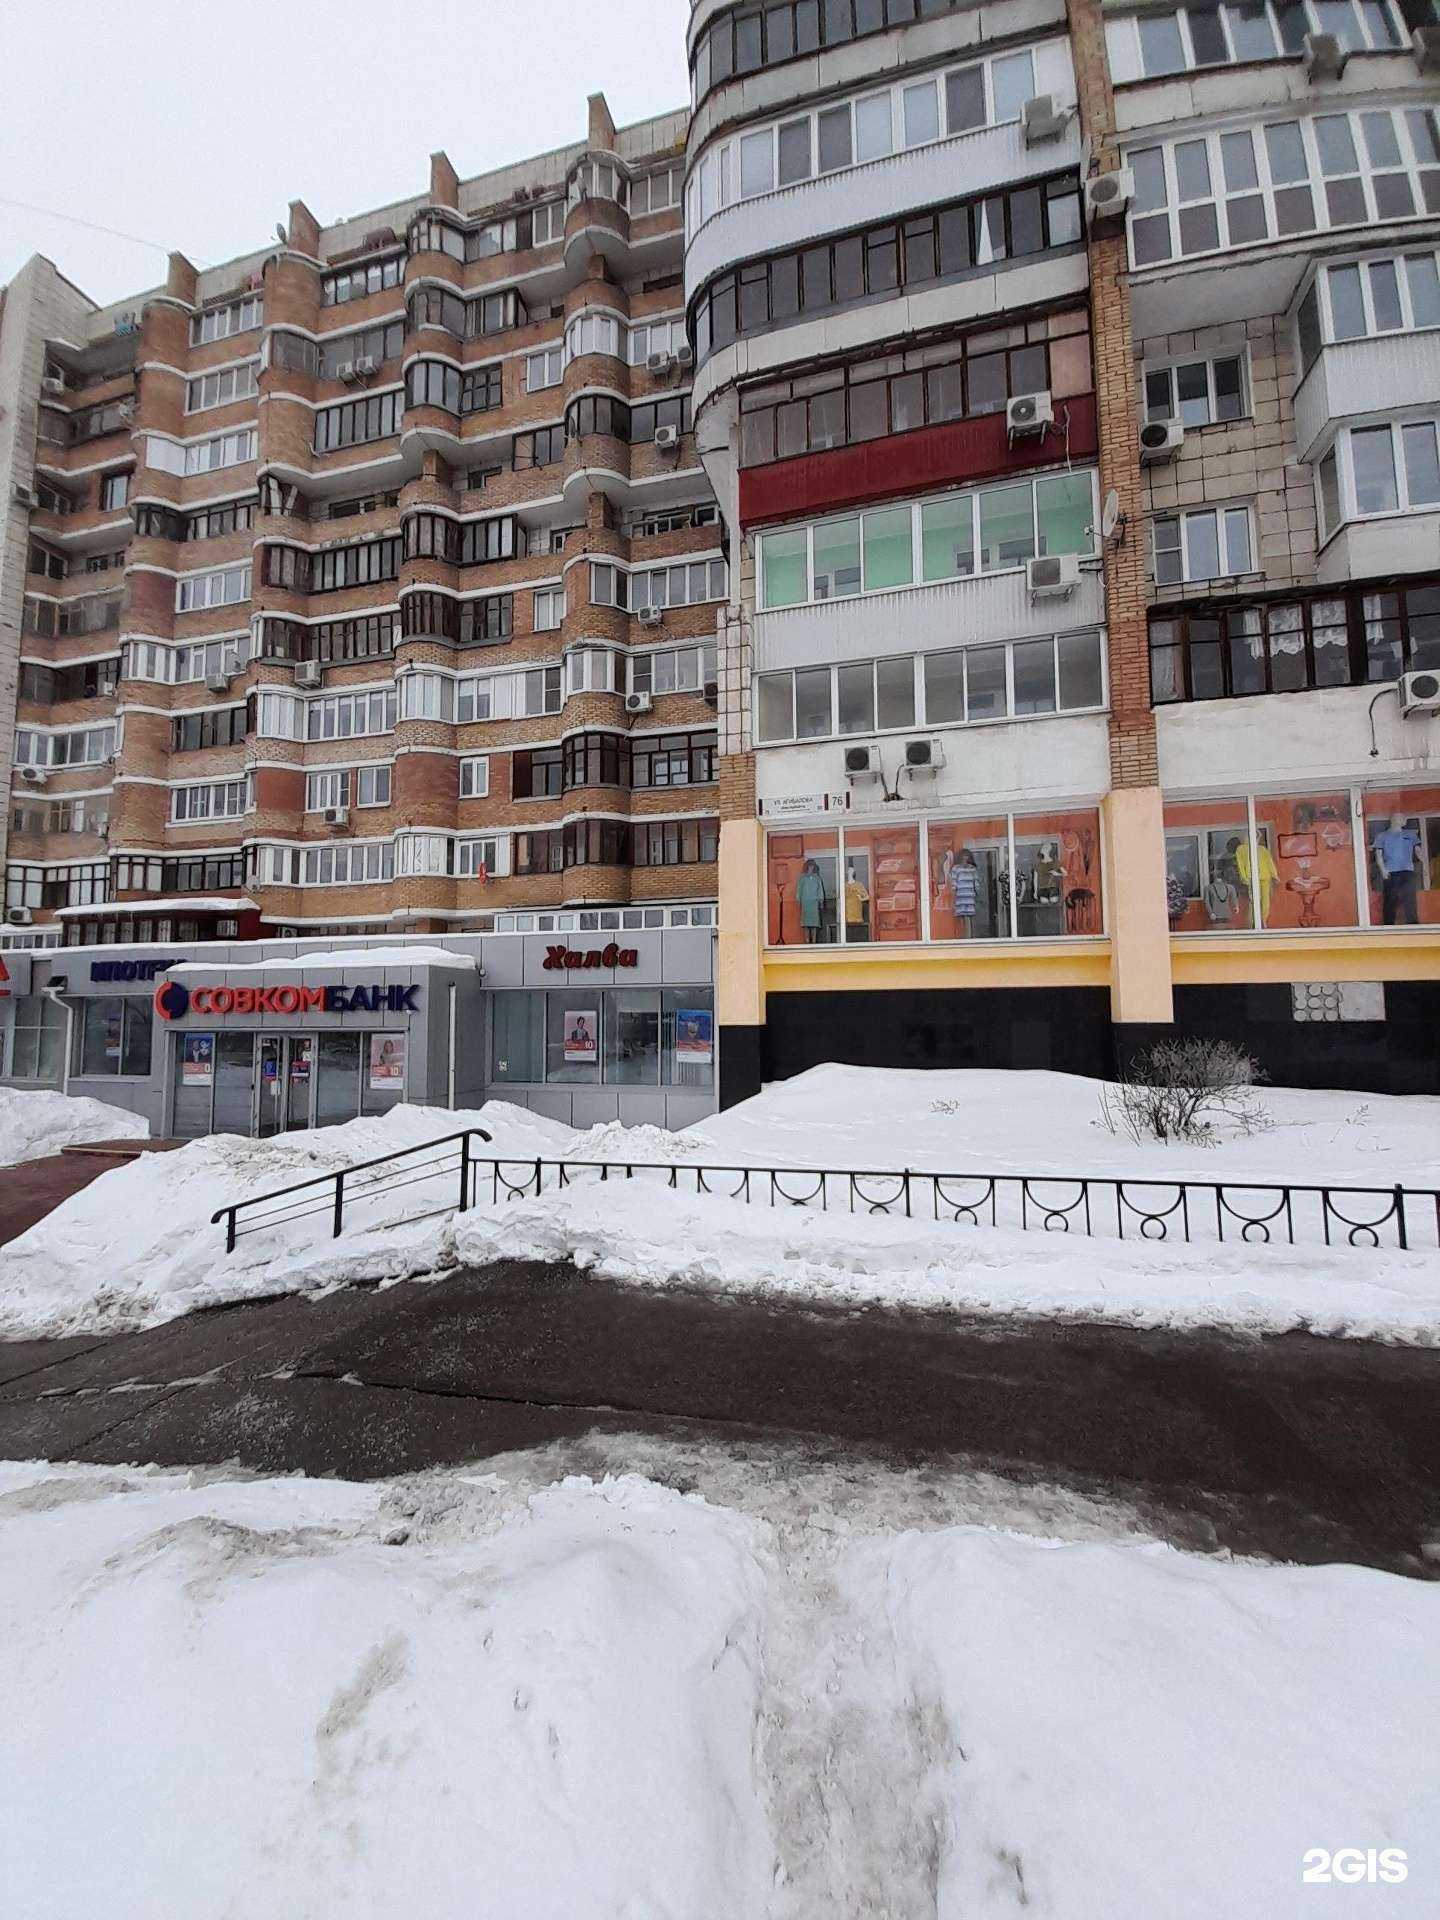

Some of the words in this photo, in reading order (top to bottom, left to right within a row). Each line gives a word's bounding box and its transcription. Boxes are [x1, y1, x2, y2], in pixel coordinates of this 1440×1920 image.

[832, 795, 844, 808] 76
[543, 943, 639, 970] Халва
[90, 958, 189, 981] ИПОТЕ
[191, 984, 421, 1014] СОВКОМБАНК
